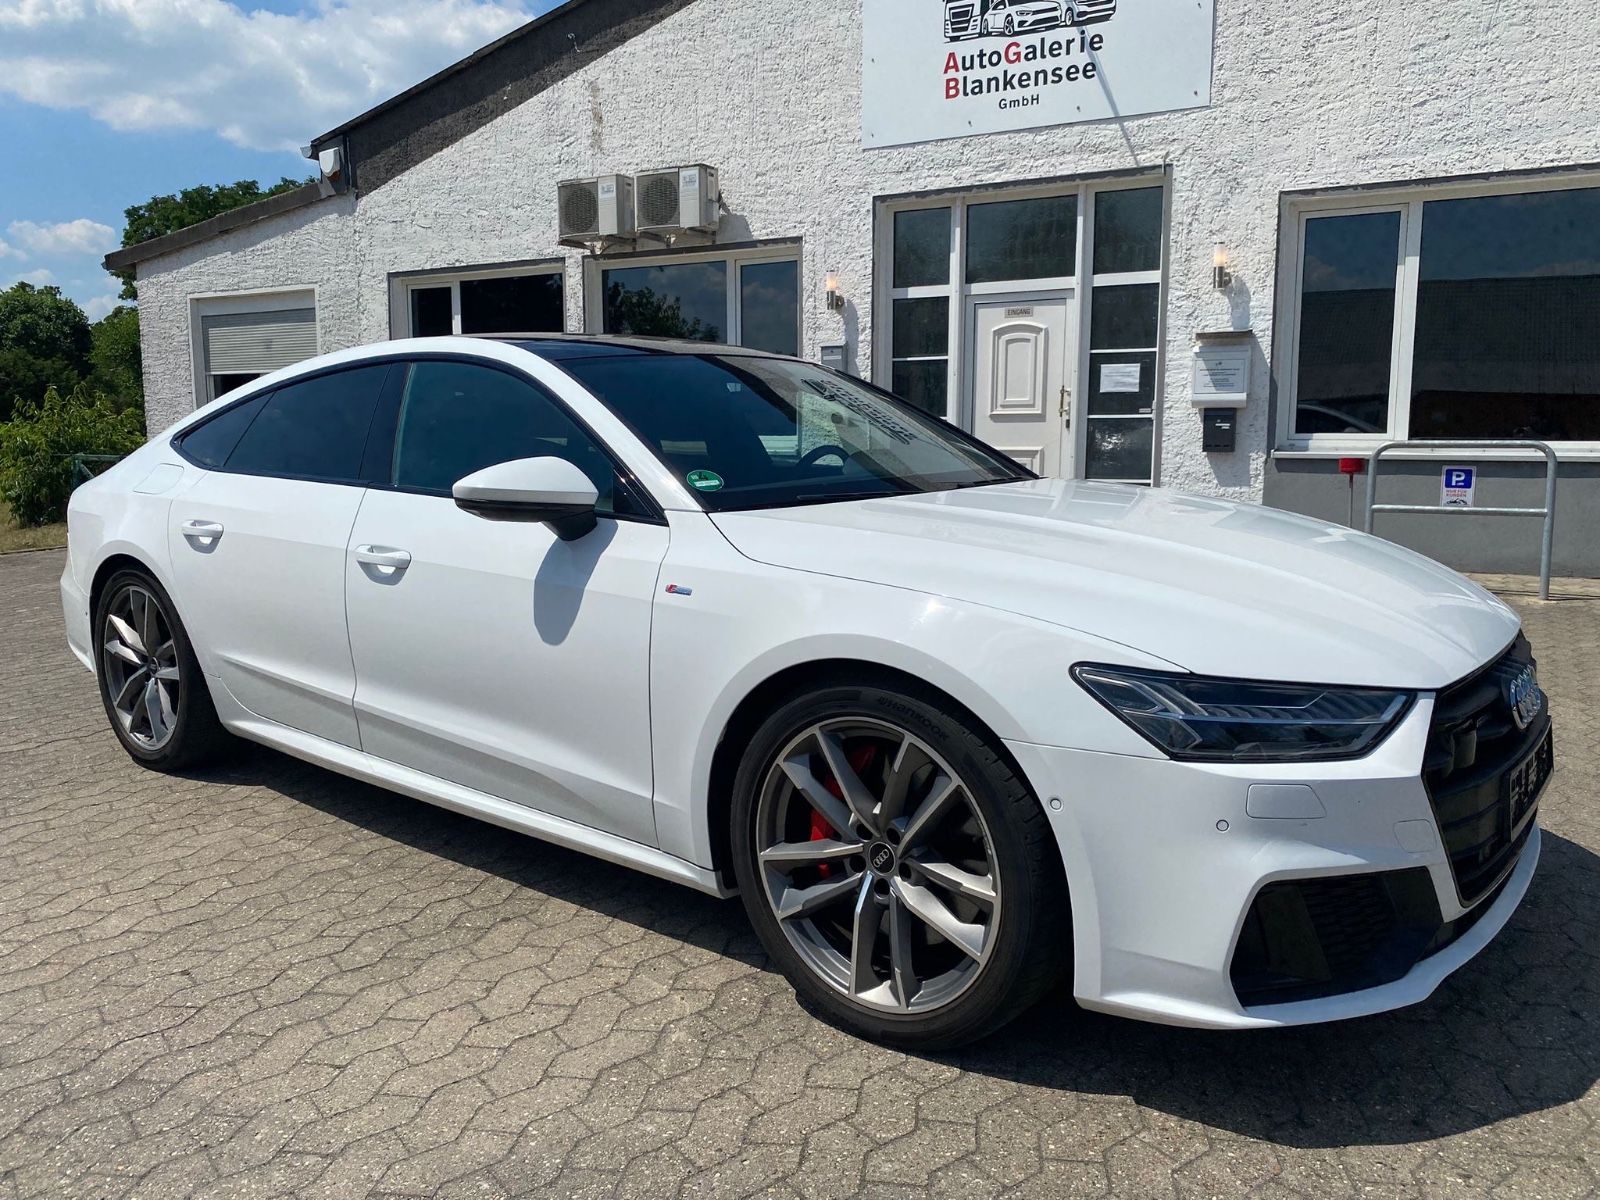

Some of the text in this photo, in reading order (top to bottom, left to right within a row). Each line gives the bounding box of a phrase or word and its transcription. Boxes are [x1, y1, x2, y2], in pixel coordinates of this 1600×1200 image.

[943, 29, 1104, 74] AutoGalerie
[945, 61, 1097, 99] Blankensee
[998, 93, 1040, 109] GmbH
[1451, 471, 1466, 486] P
